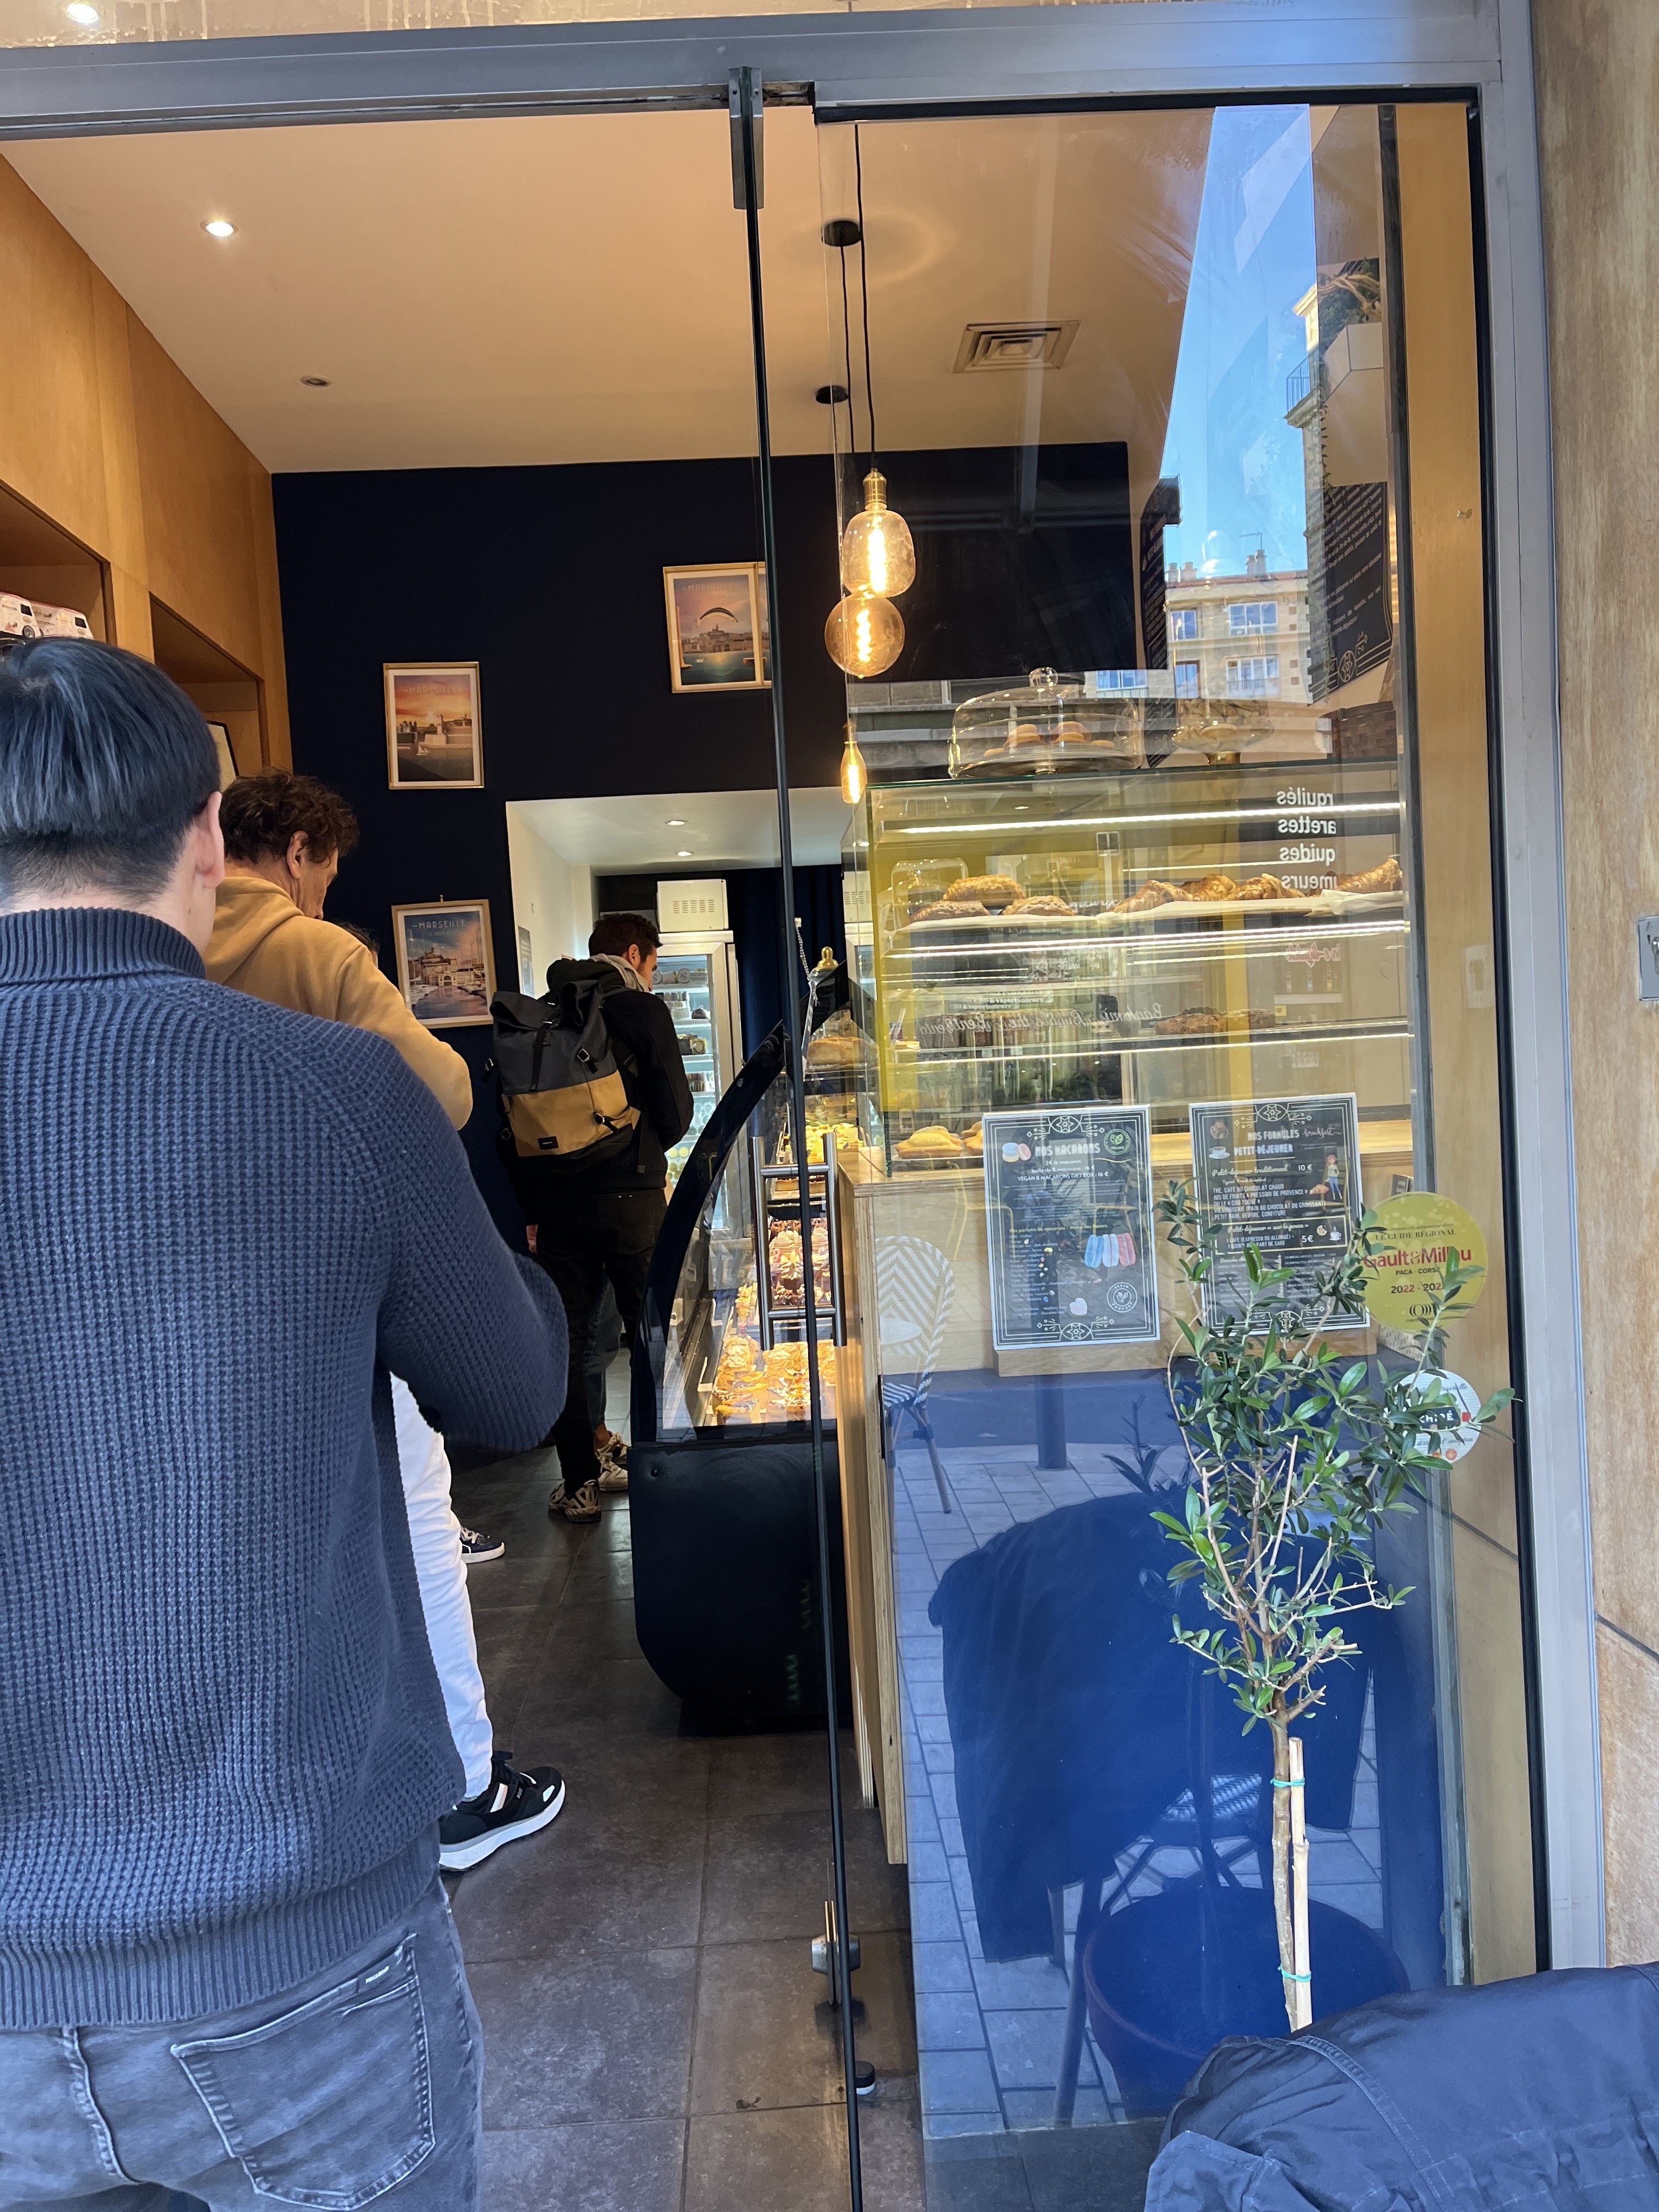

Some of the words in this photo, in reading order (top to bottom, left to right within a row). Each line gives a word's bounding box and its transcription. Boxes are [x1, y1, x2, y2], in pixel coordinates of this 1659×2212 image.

[409, 686, 456, 695] MARSEILLE
[419, 919, 466, 929] MARSEILLE
[1247, 1132, 1262, 1141] NOS
[1263, 1129, 1300, 1141] FORMULES
[1035, 1146, 1053, 1157] NOS
[1055, 1143, 1101, 1155] MACARONS
[1301, 1234, 1314, 1243] 5€
[1415, 1229, 1457, 1238] RÉGIONAL
[1363, 1246, 1472, 1268] Gault&Millu
[1391, 1284, 1415, 1294] 2022
[1423, 1283, 1444, 1291] 202
